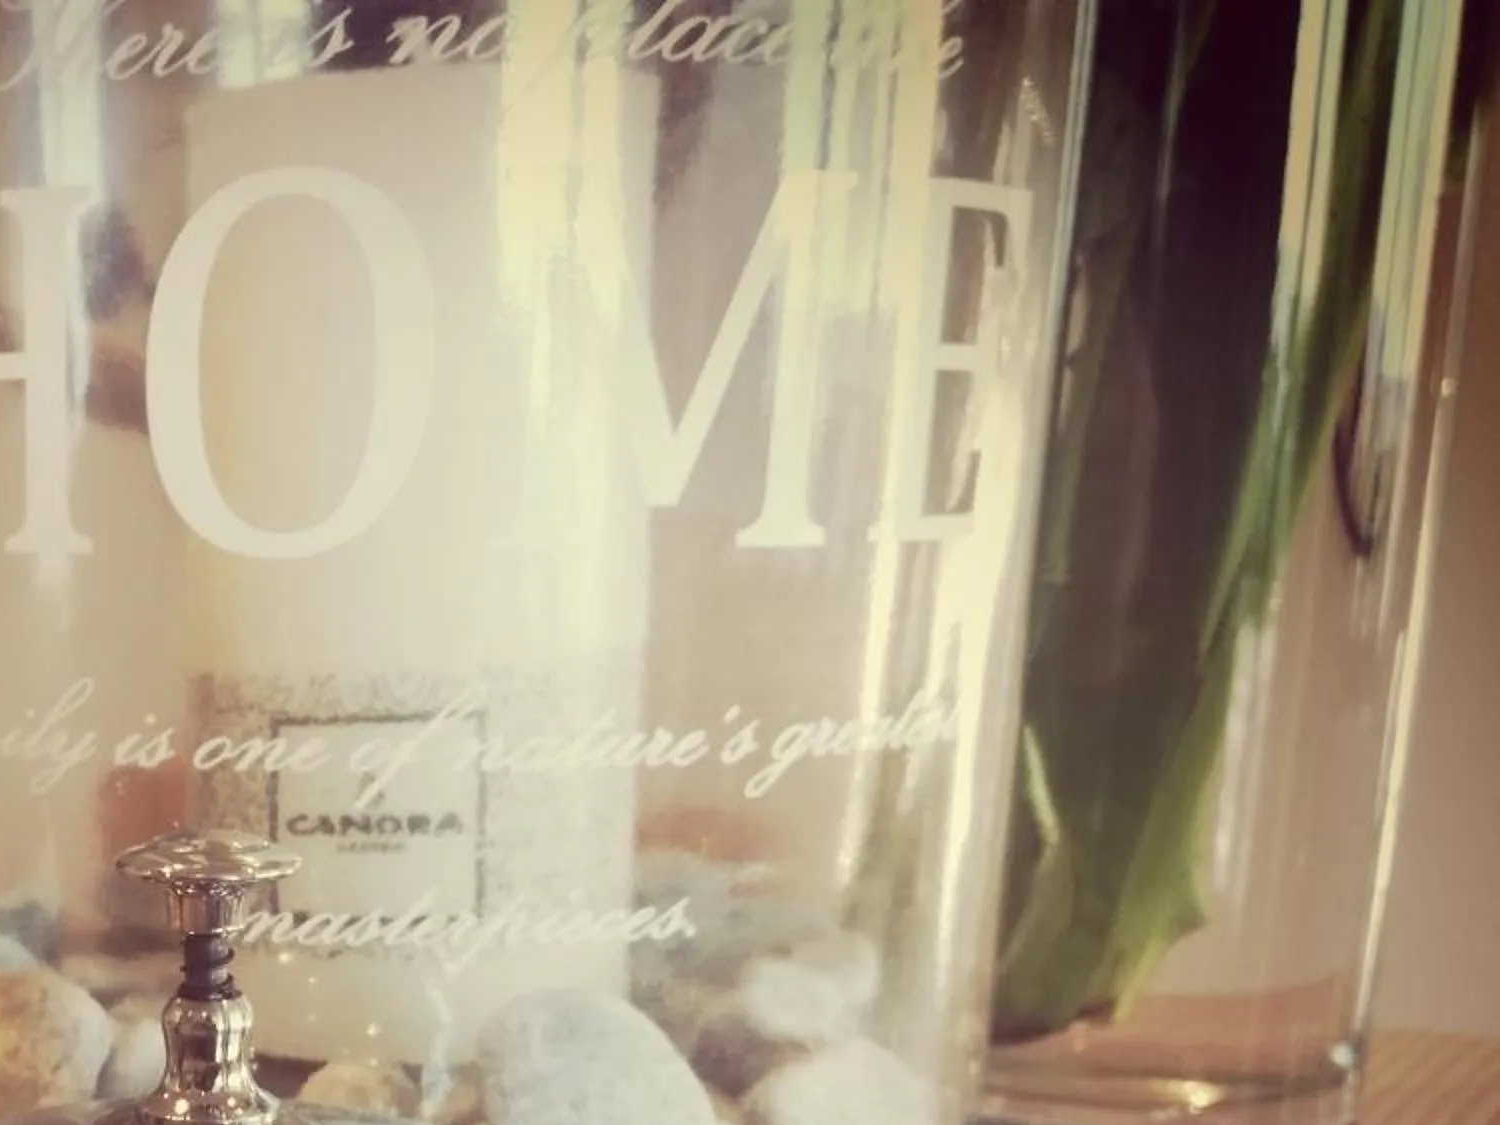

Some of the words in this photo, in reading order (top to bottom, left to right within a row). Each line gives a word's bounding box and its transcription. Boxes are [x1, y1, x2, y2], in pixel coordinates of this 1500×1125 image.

[113, 712, 176, 768] is
[193, 735, 332, 772] one
[348, 683, 490, 810] of
